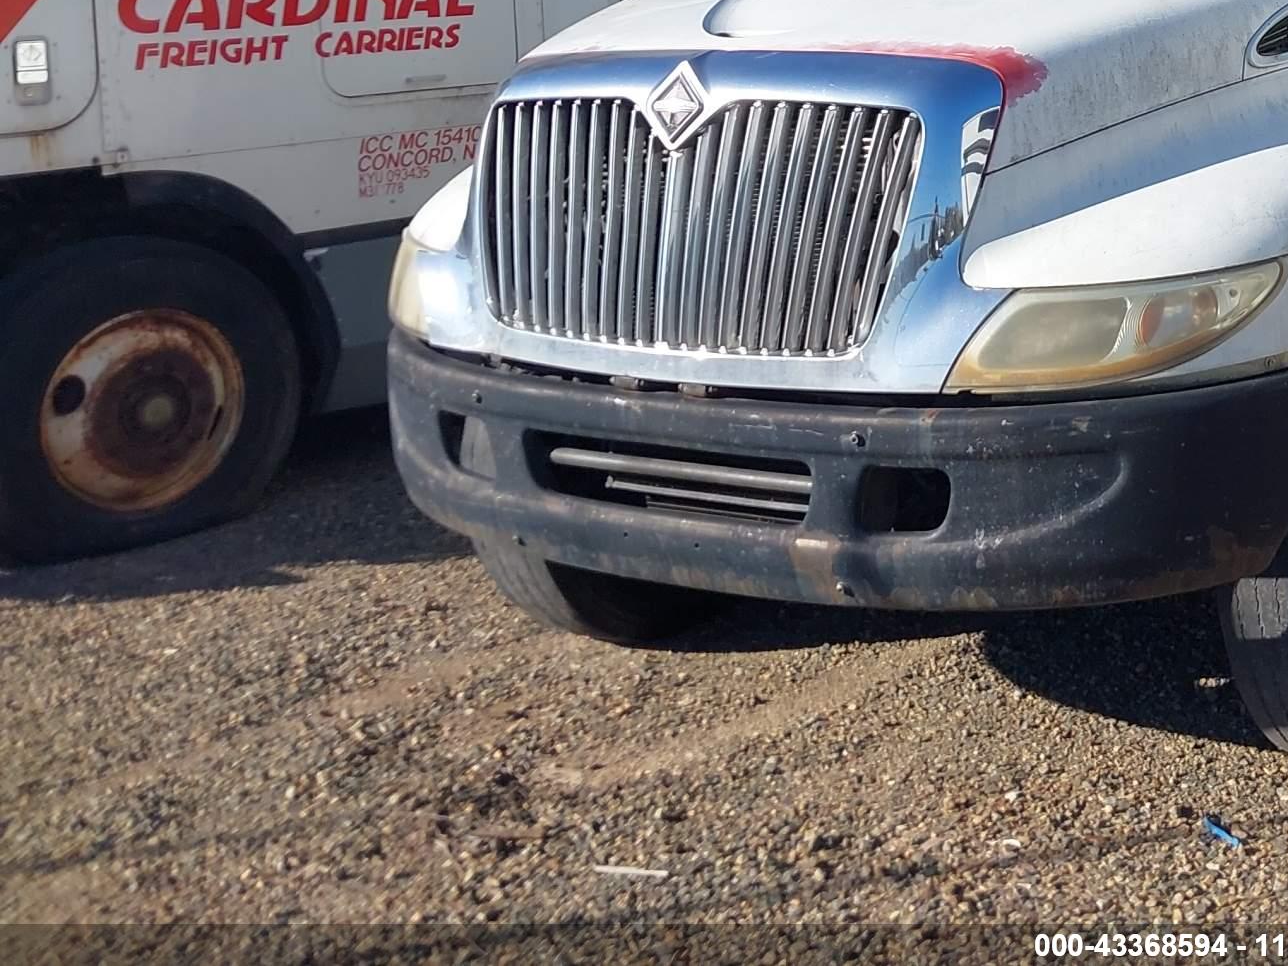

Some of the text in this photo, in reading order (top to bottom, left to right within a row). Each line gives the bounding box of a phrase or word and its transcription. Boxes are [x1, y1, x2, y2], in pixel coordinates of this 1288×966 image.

[135, 24, 461, 70] FREIGHT CARRIERS
[359, 135, 393, 155] ICC
[398, 131, 428, 151] MC
[358, 146, 457, 173] CONCORD,
